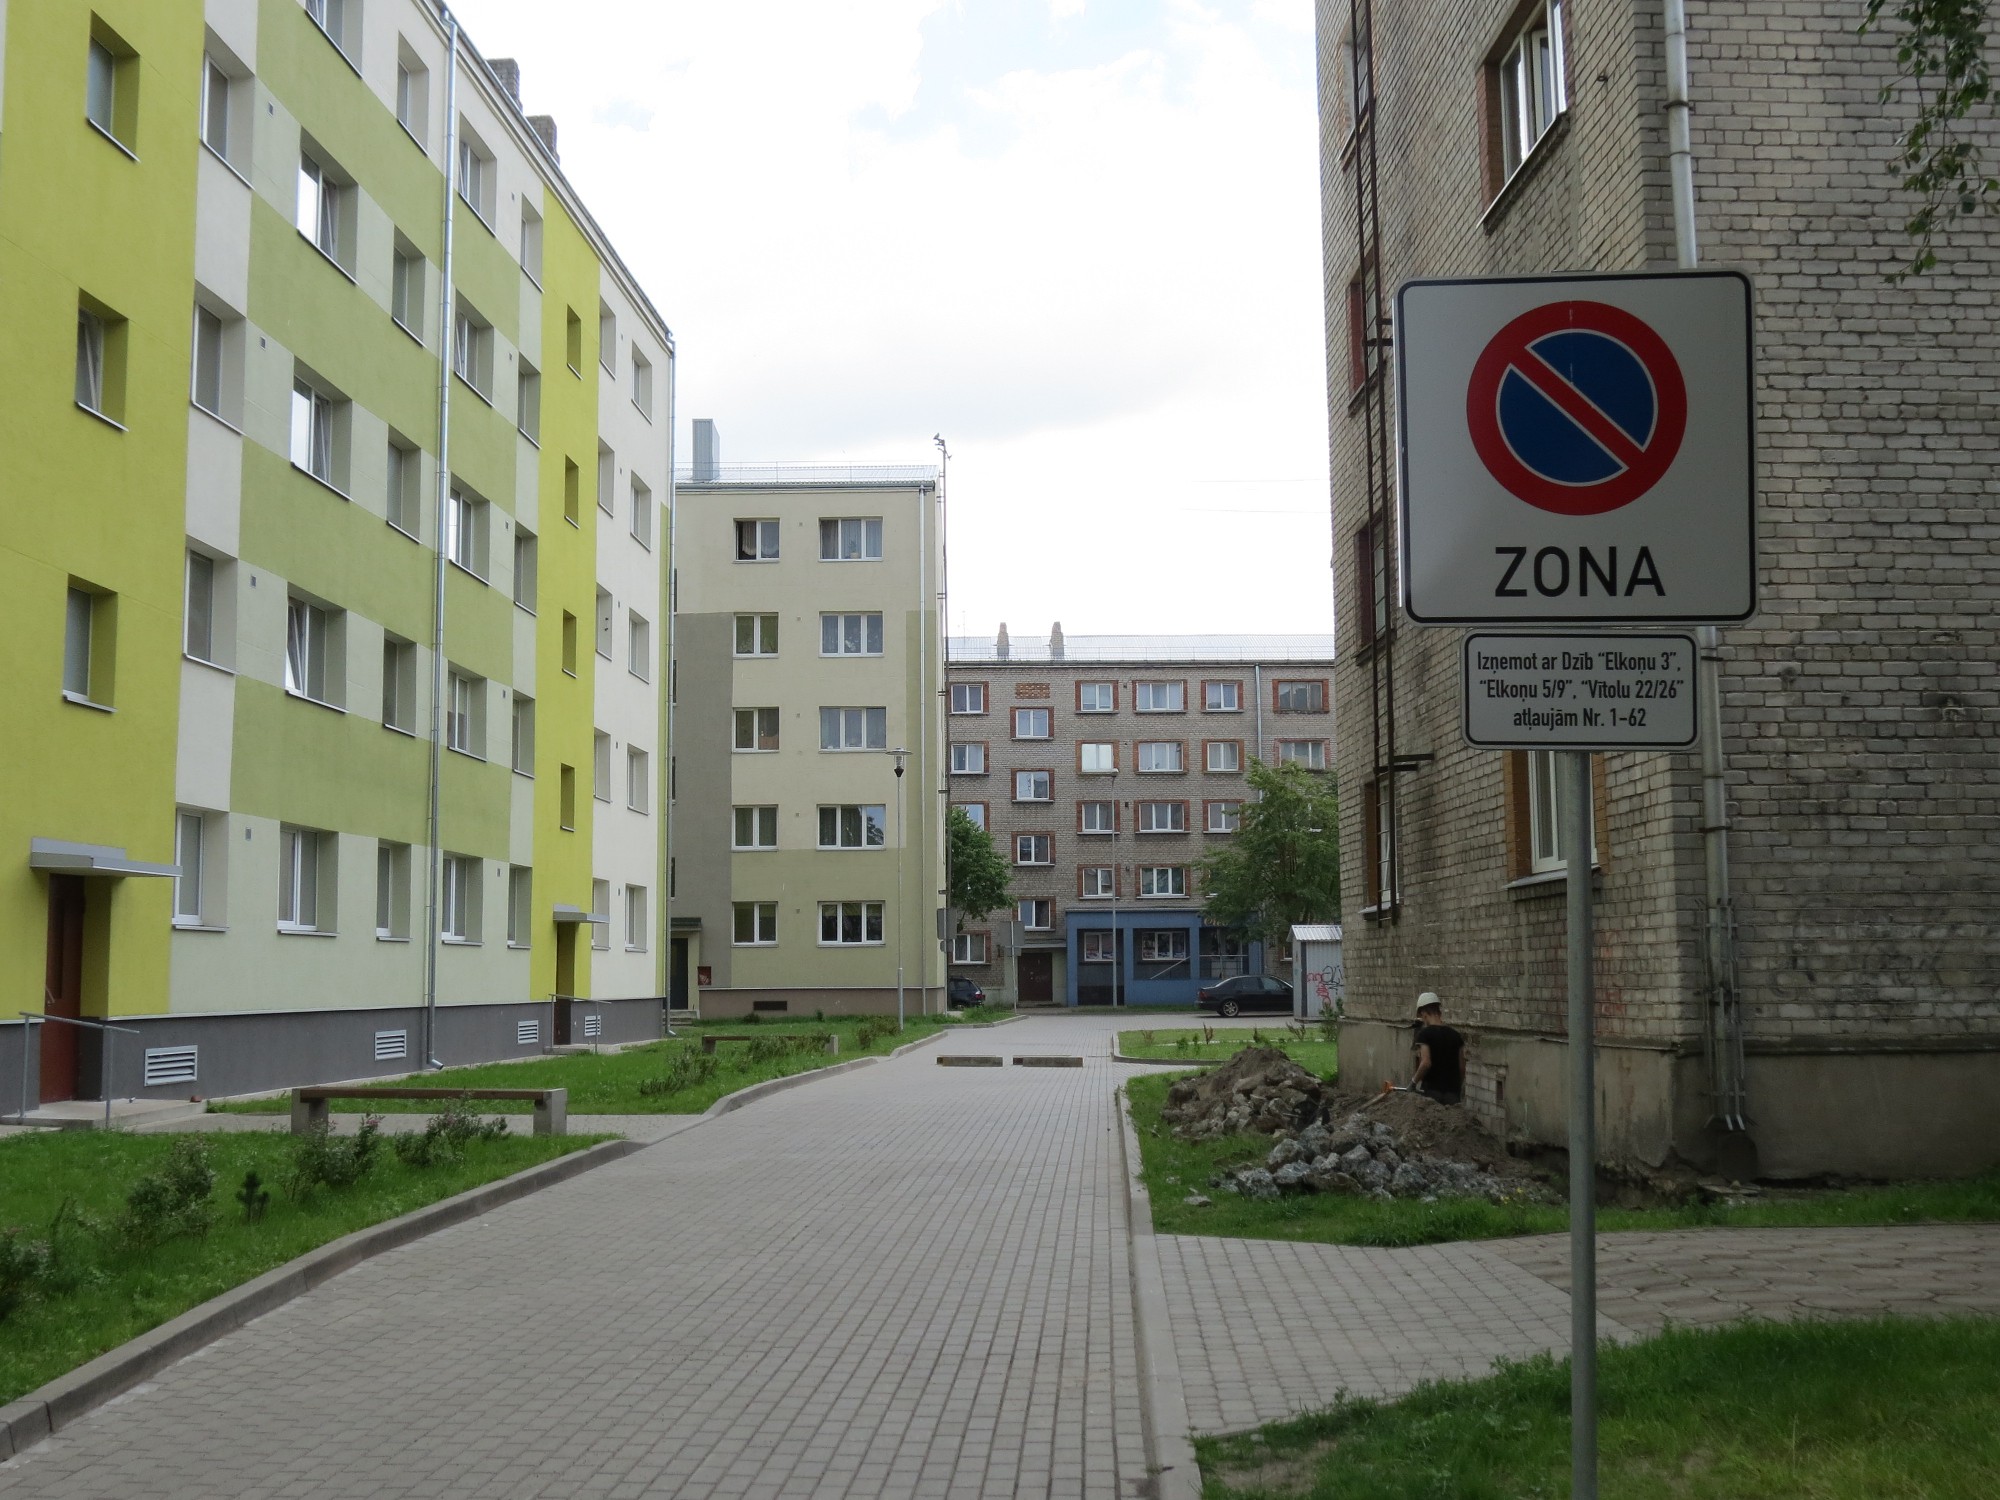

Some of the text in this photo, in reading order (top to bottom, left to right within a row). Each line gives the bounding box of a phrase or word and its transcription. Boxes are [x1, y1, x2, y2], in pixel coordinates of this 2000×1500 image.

[1495, 545, 1666, 597] ZONA
[1477, 651, 1538, 674] Izņemot
[1541, 656, 1557, 670] ar
[1562, 651, 1593, 670] Dzīb
[1513, 707, 1647, 731] atļaujām Nr. 1-62
